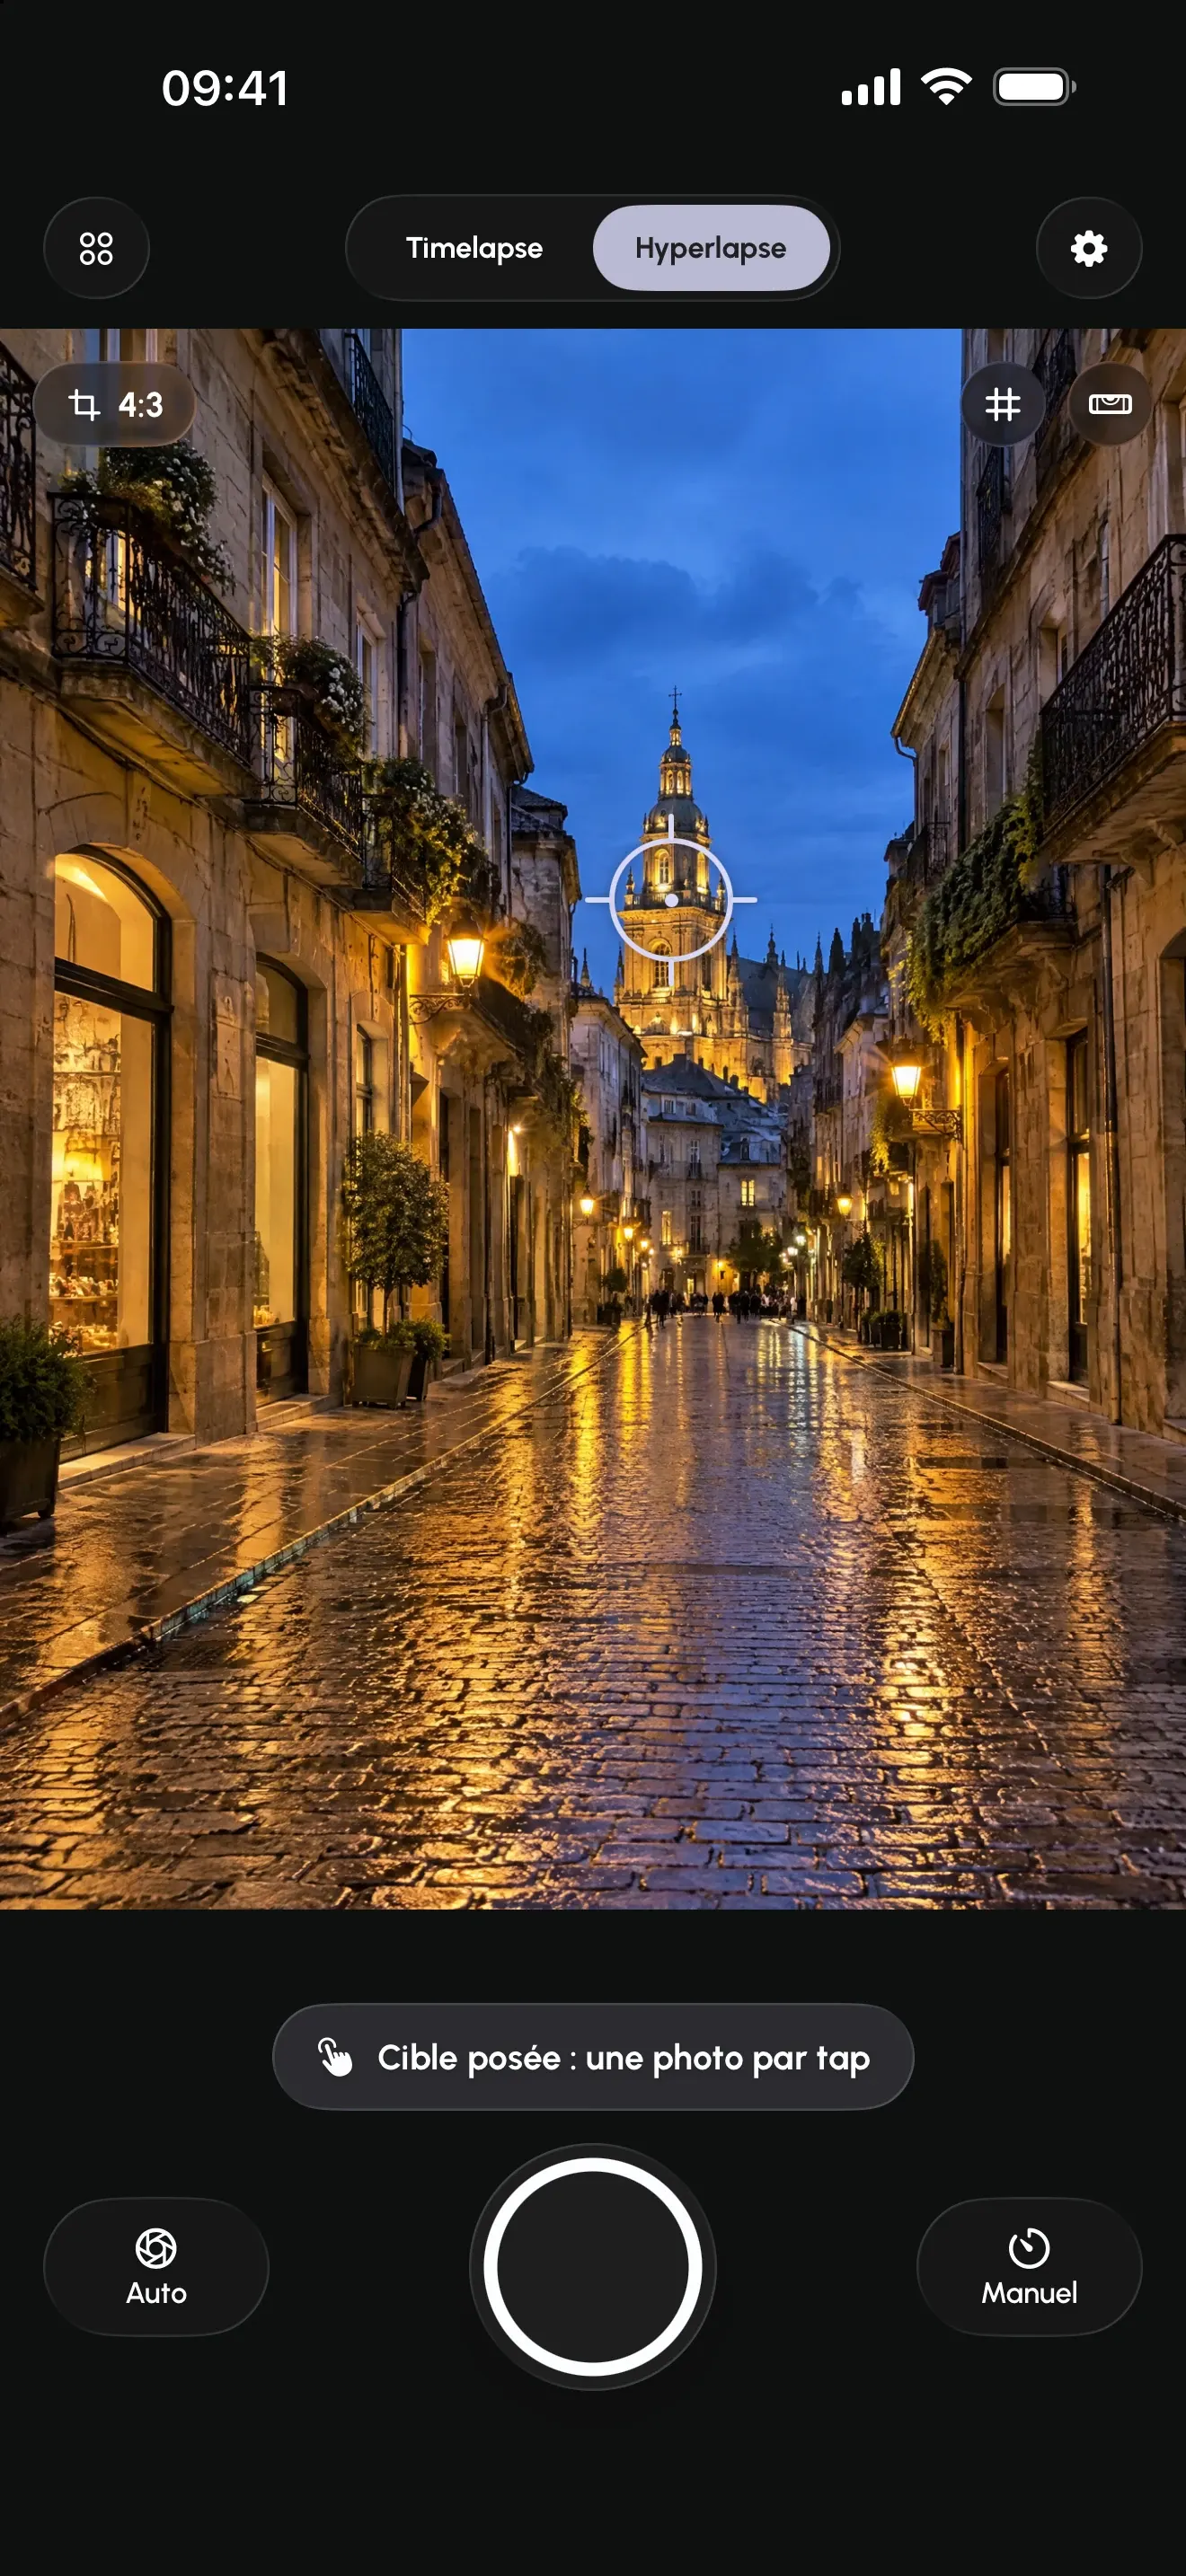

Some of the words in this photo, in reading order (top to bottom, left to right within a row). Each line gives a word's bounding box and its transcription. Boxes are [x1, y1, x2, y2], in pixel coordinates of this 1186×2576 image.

[163, 69, 288, 106] 09:41
[406, 235, 543, 266] Timelapse
[636, 235, 786, 266] Hyperlapse
[119, 392, 164, 419] 4:3
[378, 2043, 457, 2070] Cible
[469, 2045, 561, 2078] posée
[571, 2052, 575, 2069] :
[587, 2051, 643, 2070] une
[654, 2043, 743, 2078] photo
[754, 2051, 808, 2078] par
[817, 2046, 870, 2078] tap
[126, 2282, 187, 2304] Auto
[982, 2280, 1076, 2304] Manuel
